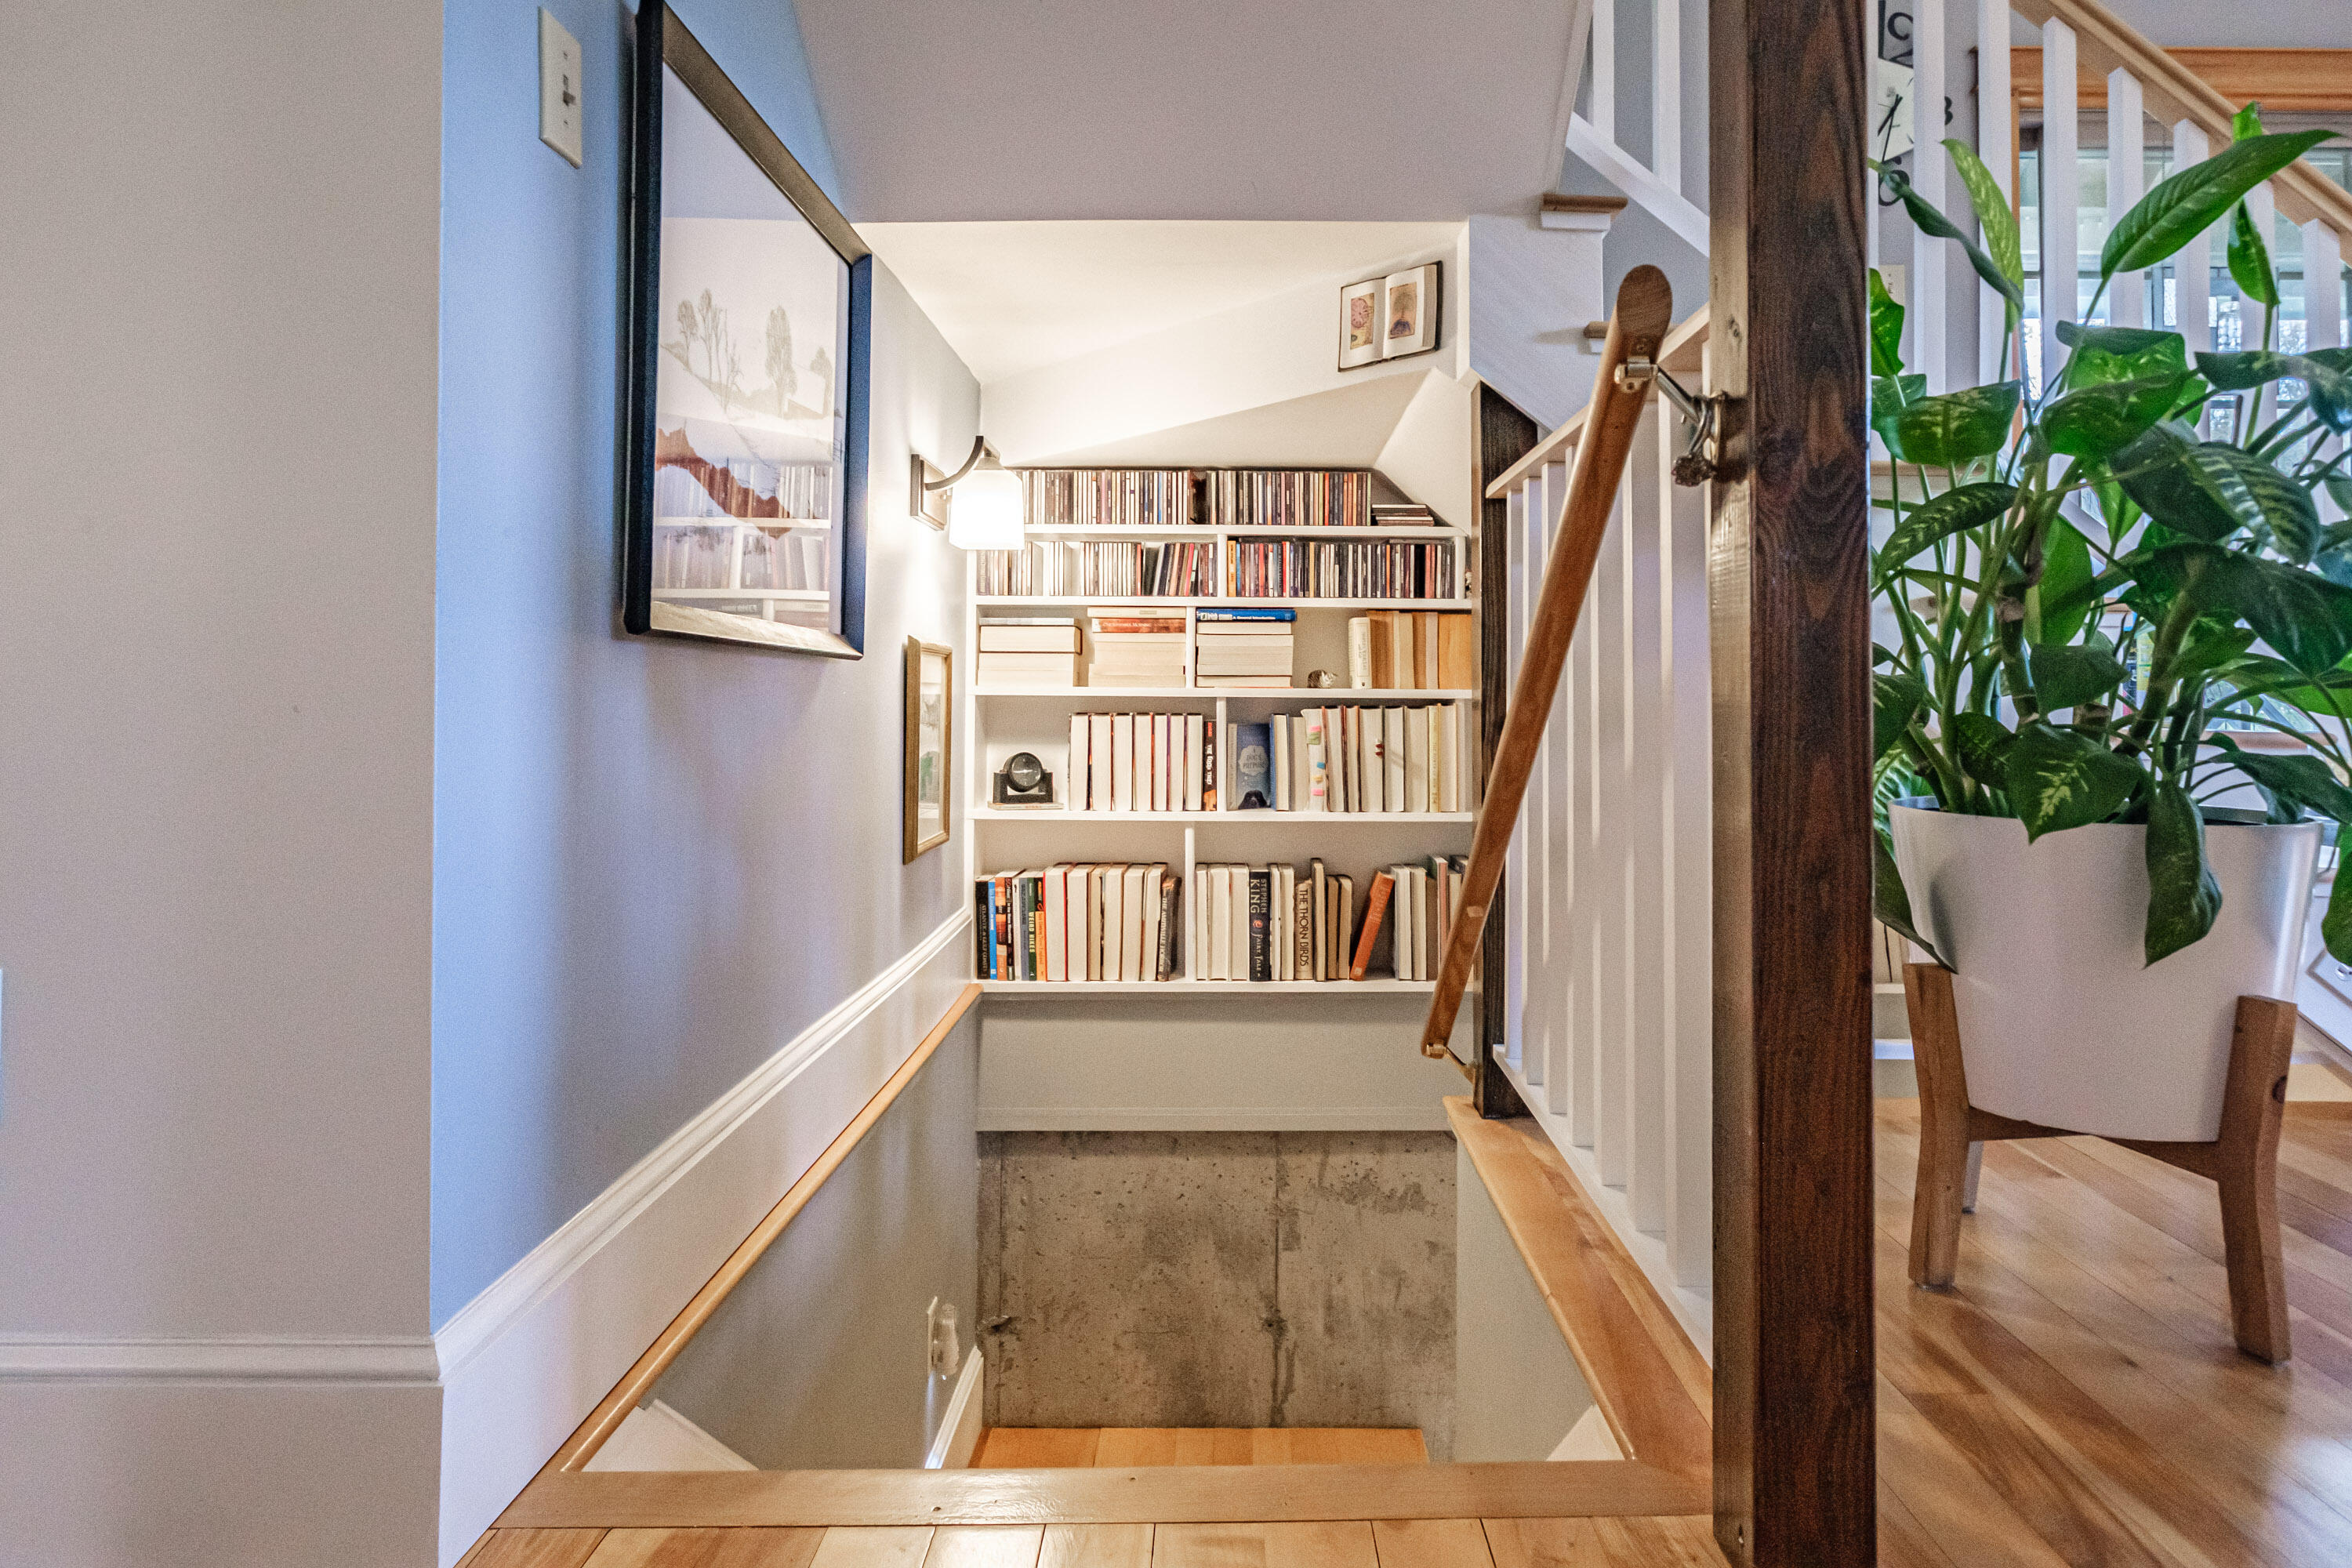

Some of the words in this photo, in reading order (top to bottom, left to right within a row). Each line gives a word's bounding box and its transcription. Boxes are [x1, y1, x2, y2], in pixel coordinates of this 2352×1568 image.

[1250, 878, 1261, 913] KING
[1299, 889, 1308, 904] THE
[1299, 906, 1308, 939] THORN
[1300, 942, 1308, 967] BIRDS
